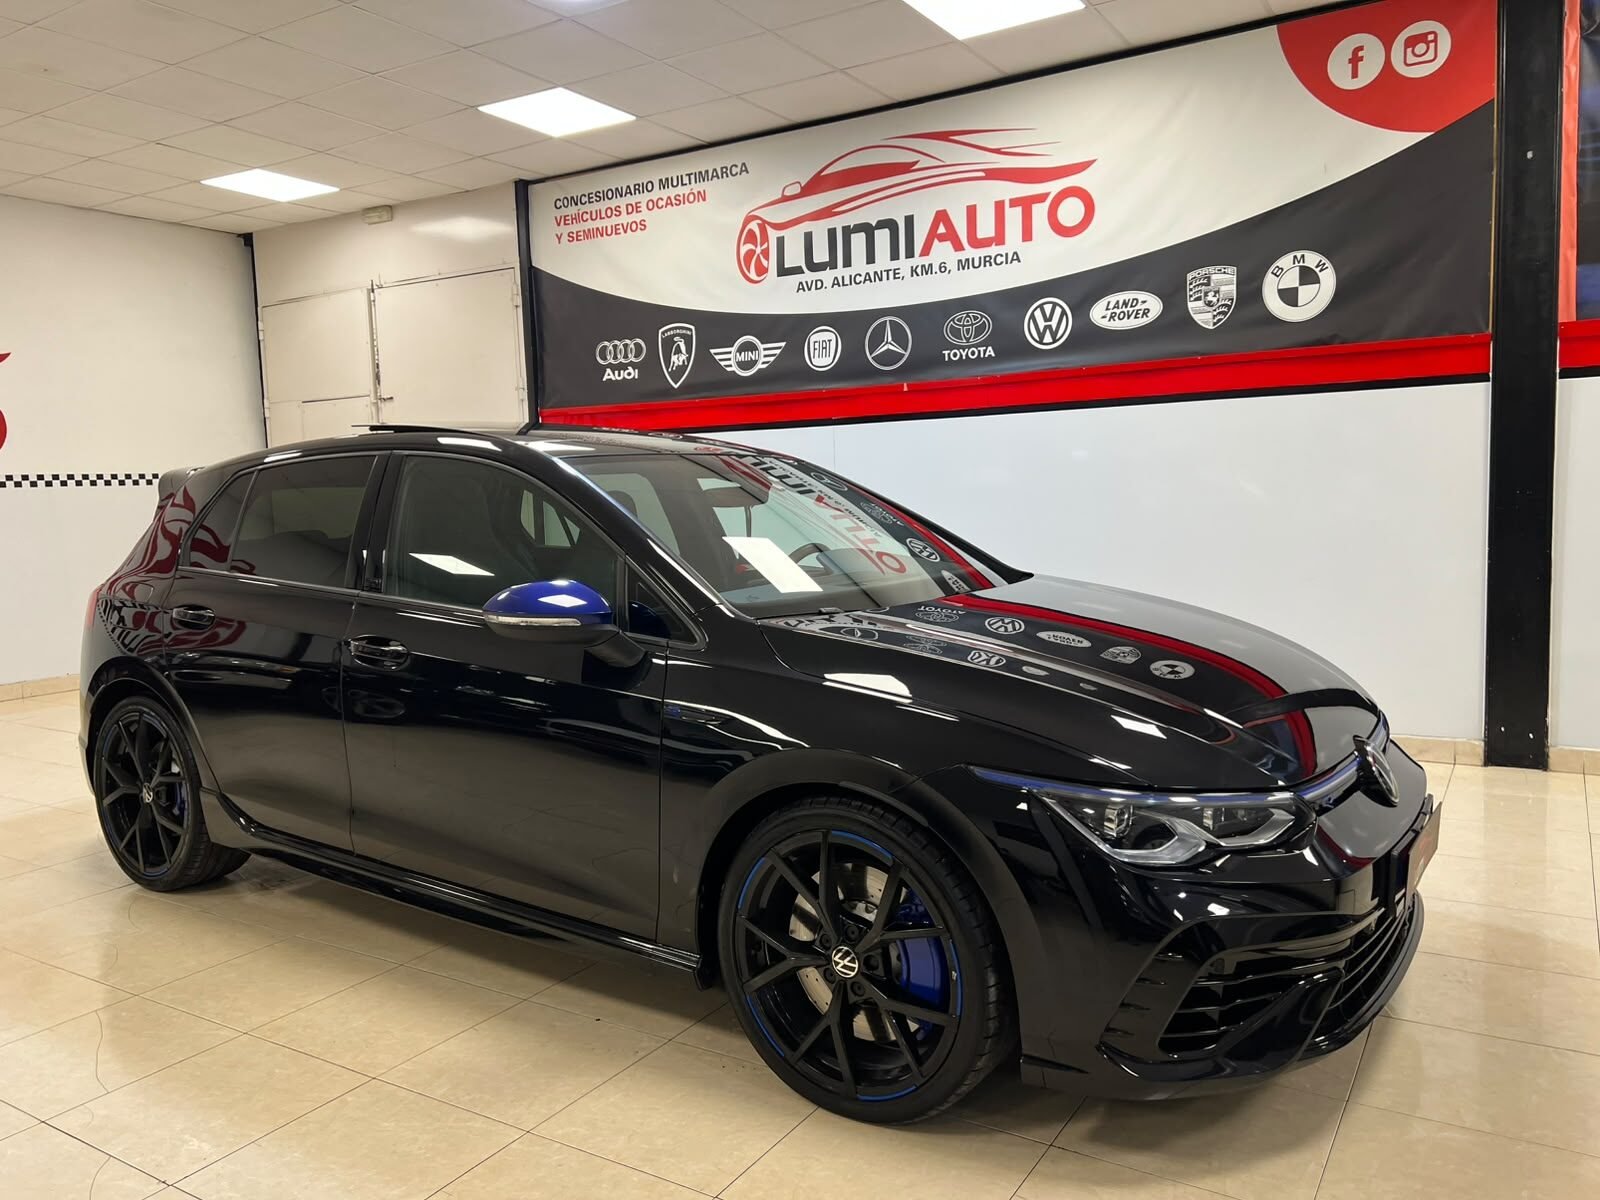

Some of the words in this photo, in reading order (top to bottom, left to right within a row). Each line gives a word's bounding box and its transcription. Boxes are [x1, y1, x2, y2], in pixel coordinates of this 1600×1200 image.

[553, 180, 655, 210] CONCESIONARIO
[658, 161, 750, 191] MULTIMARCA
[554, 204, 622, 228] VEHÍCULOS
[625, 201, 642, 215] DE
[645, 188, 707, 212] OCASIÓN
[555, 232, 563, 245] Y
[566, 218, 647, 244] SEMINUEVOS
[796, 278, 828, 293] AVD.
[830, 267, 905, 289] ALICANTE,
[910, 260, 952, 278] KM.6,
[956, 250, 1021, 272] MURCIA
[1270, 253, 1330, 279] BMW
[1104, 298, 1140, 312] LAND
[1107, 309, 1151, 323] ROVER
[735, 350, 759, 362] MINI
[812, 338, 833, 360] FIAT
[941, 346, 996, 362] TOYOTA
[602, 366, 639, 381] Audi
